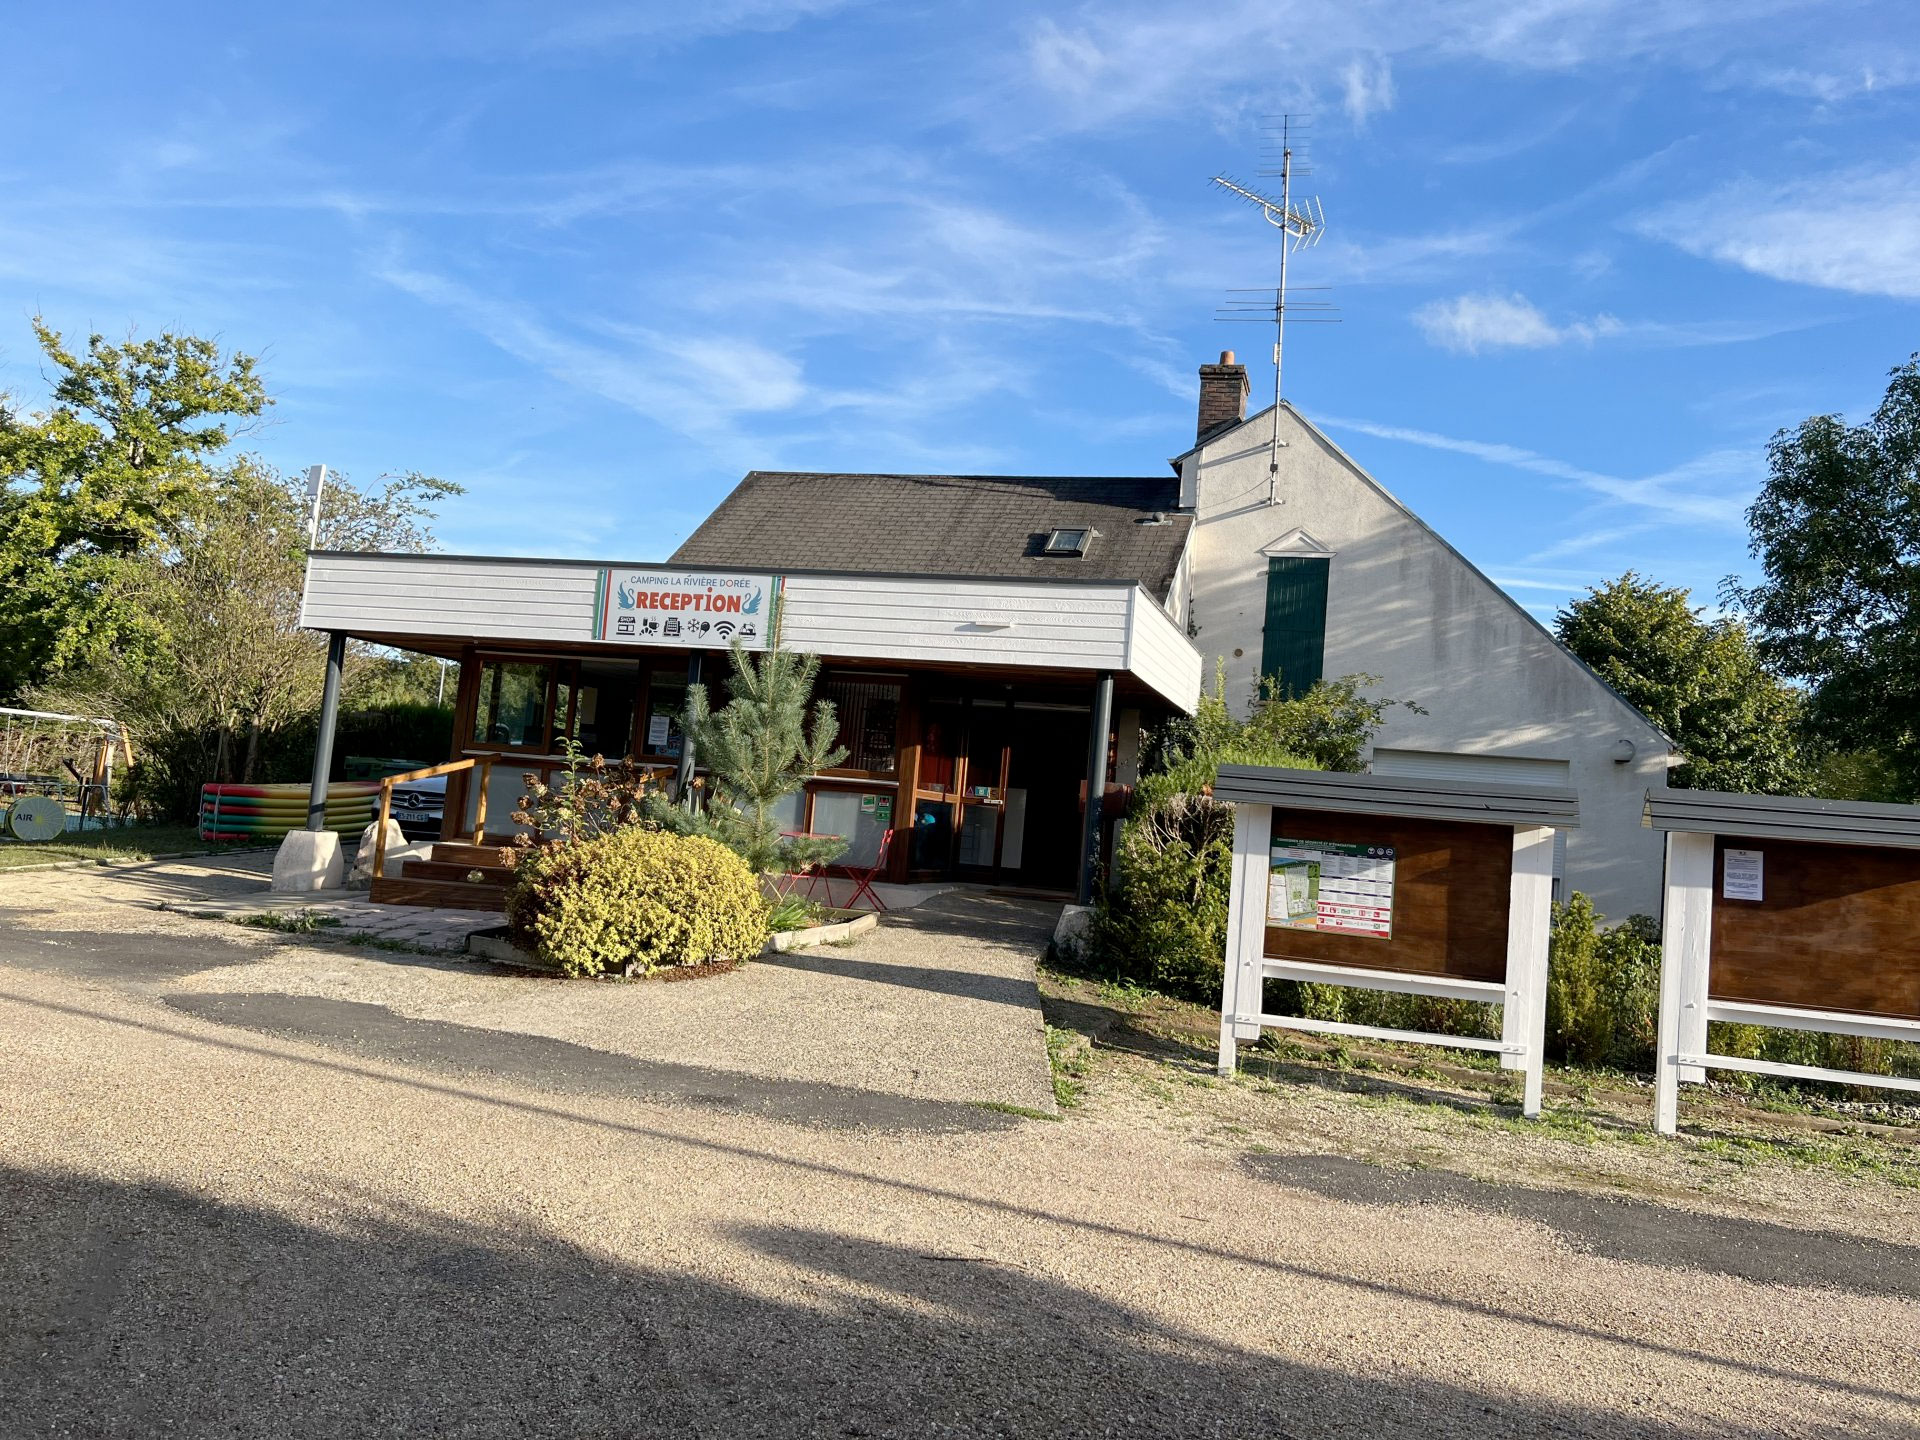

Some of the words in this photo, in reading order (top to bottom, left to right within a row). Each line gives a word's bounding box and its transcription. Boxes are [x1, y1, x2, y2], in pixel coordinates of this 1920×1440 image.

[630, 576, 669, 585] CAMPING
[670, 577, 682, 586] LA
[684, 576, 718, 587] RIVIÈRE
[719, 578, 751, 588] DORÉE
[15, 813, 33, 821] AIR
